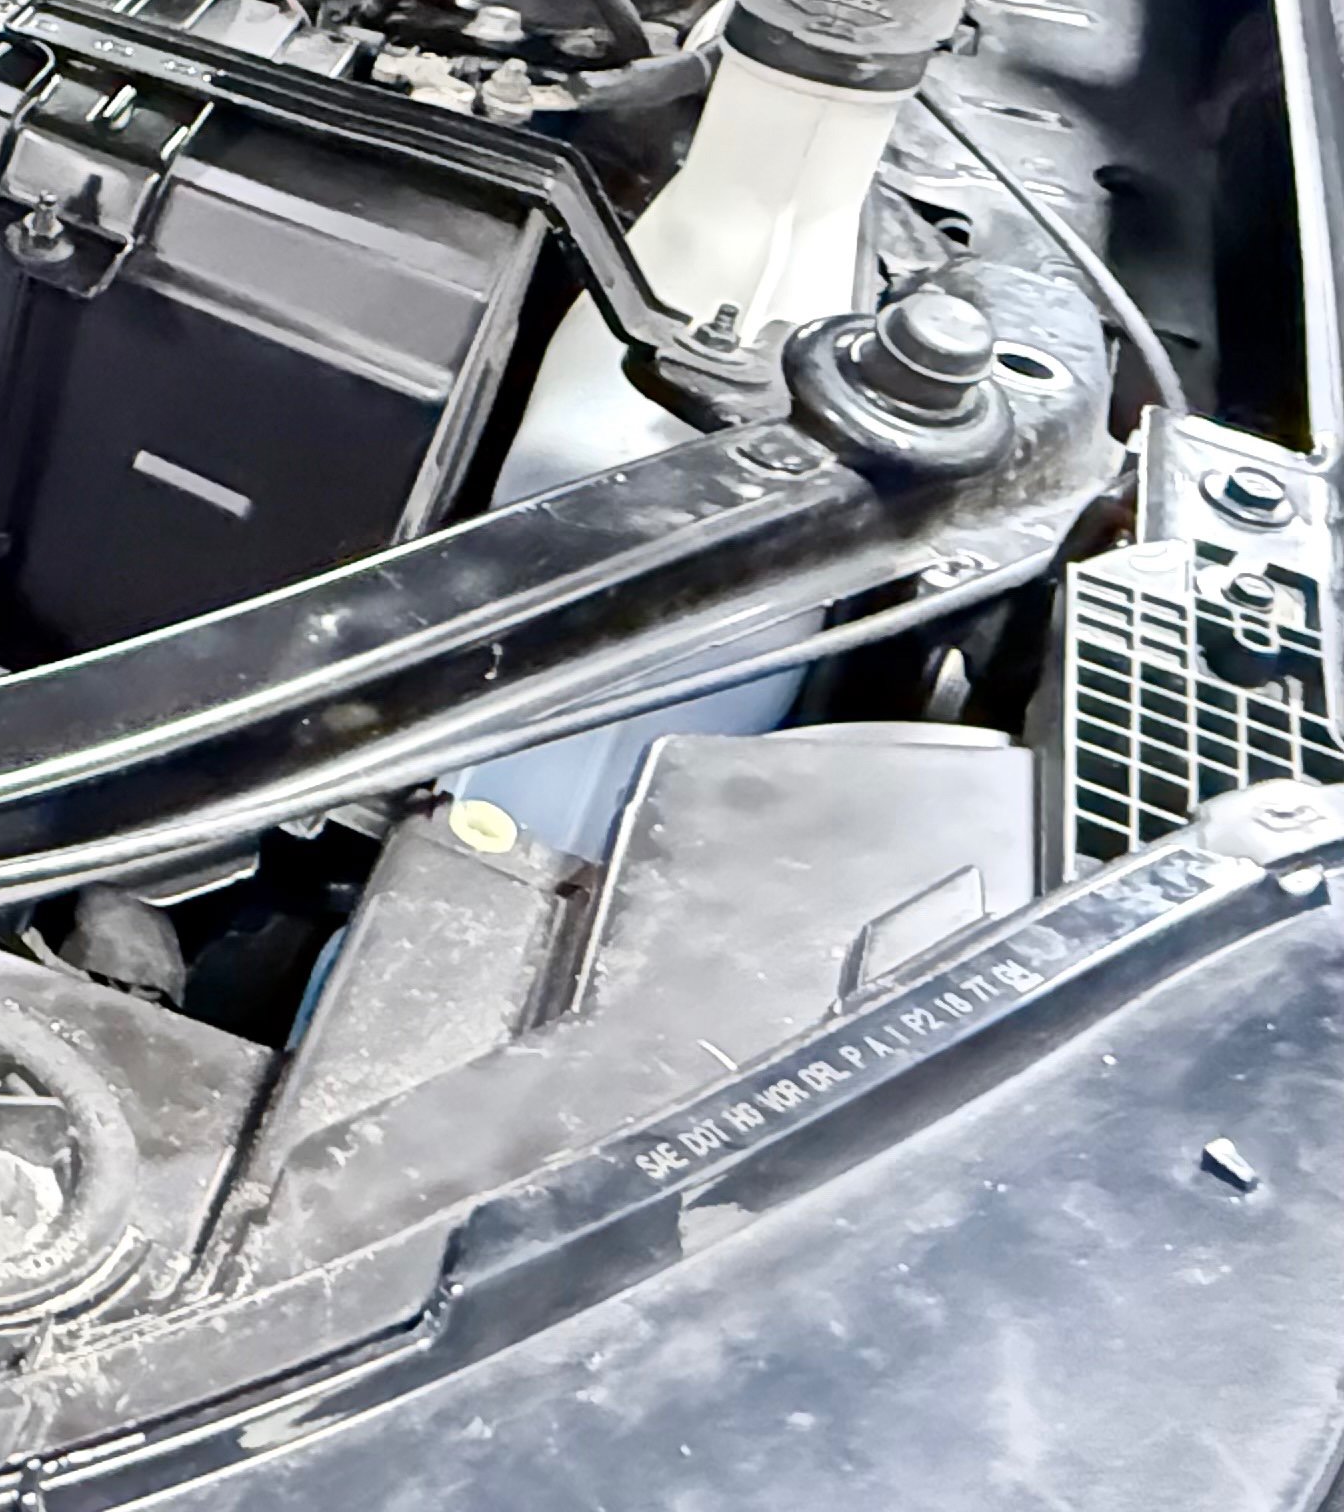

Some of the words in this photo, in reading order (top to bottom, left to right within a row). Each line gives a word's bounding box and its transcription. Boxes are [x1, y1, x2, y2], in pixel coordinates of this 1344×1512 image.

[635, 1142, 690, 1180] SAE
[678, 1118, 732, 1158] DOT
[797, 1060, 854, 1093] DRL
[838, 1044, 866, 1070] P
[863, 1035, 897, 1058] A
[899, 1007, 945, 1036] P2
